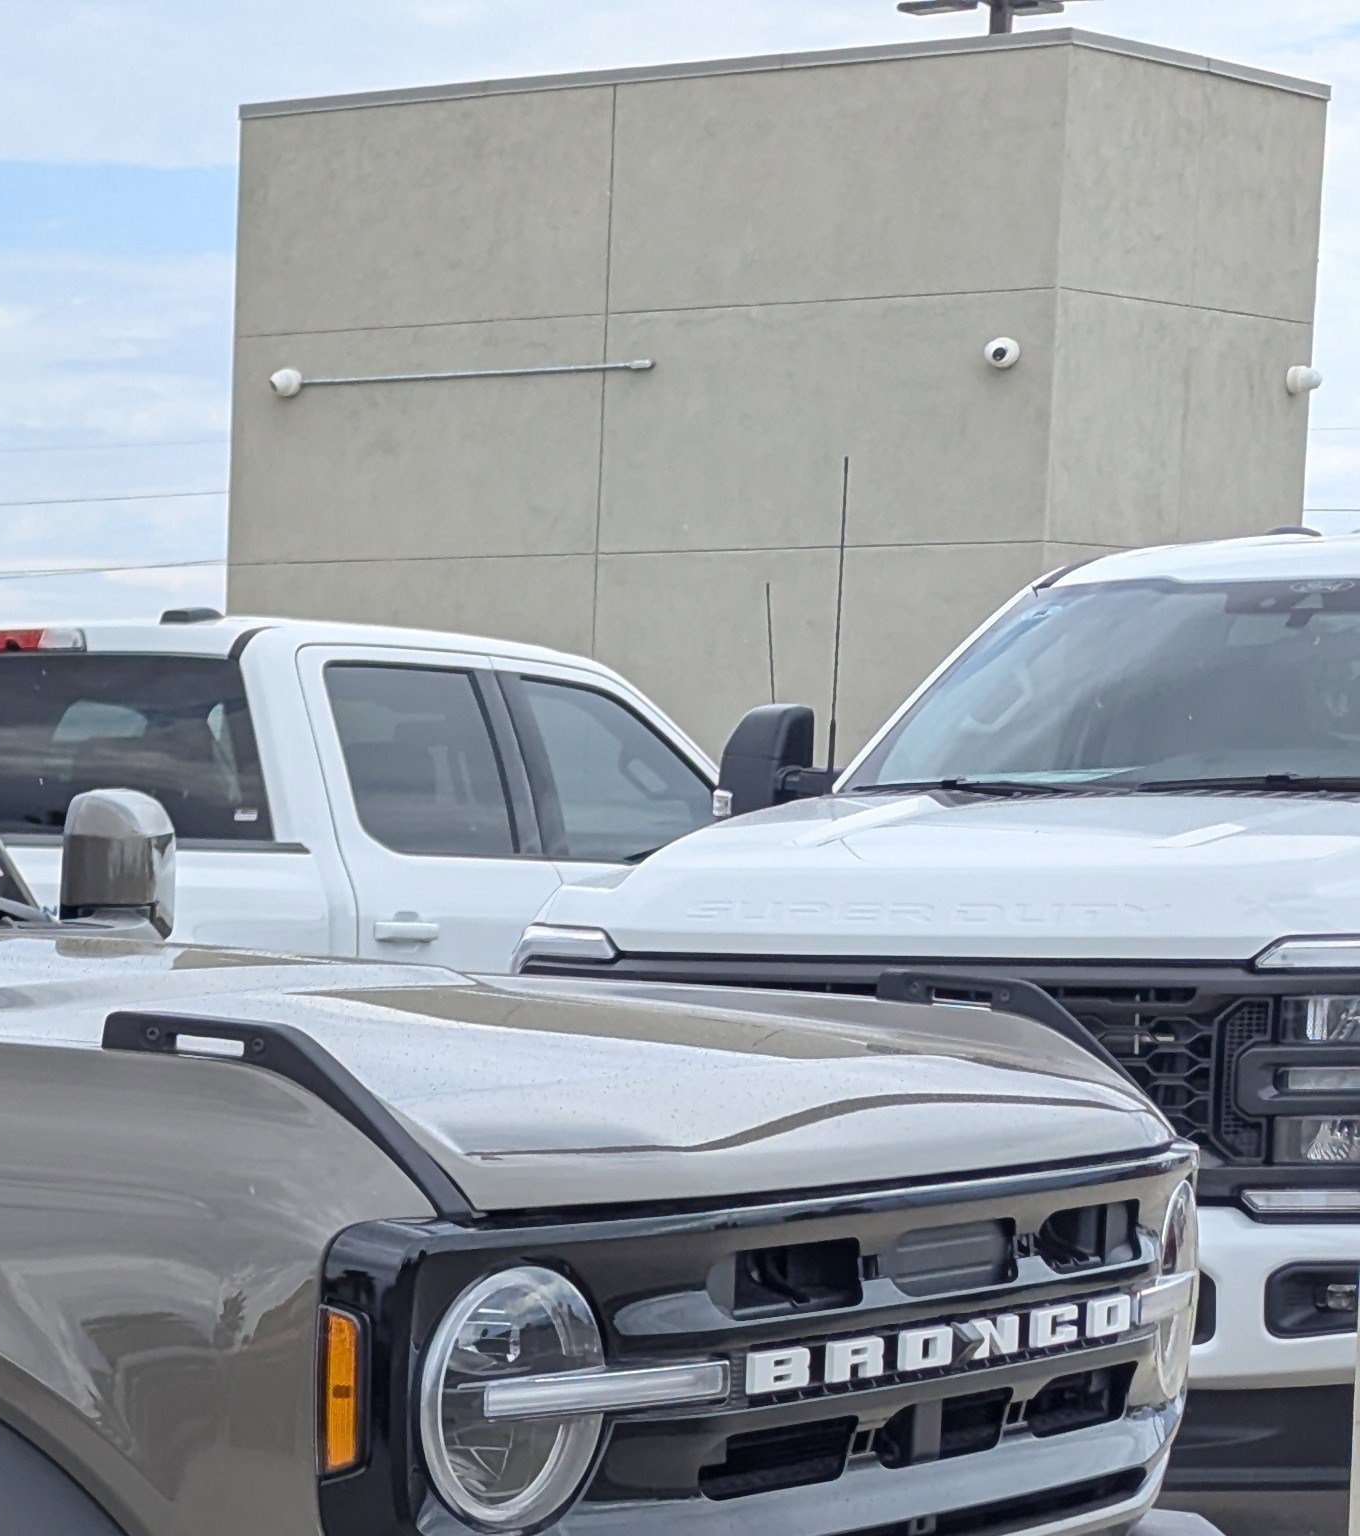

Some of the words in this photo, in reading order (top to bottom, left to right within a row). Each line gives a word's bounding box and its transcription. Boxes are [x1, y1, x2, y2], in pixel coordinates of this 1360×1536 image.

[686, 899, 936, 926] SUPER
[952, 902, 1173, 928] DUTY
[746, 1293, 1131, 1395] BRONCO
